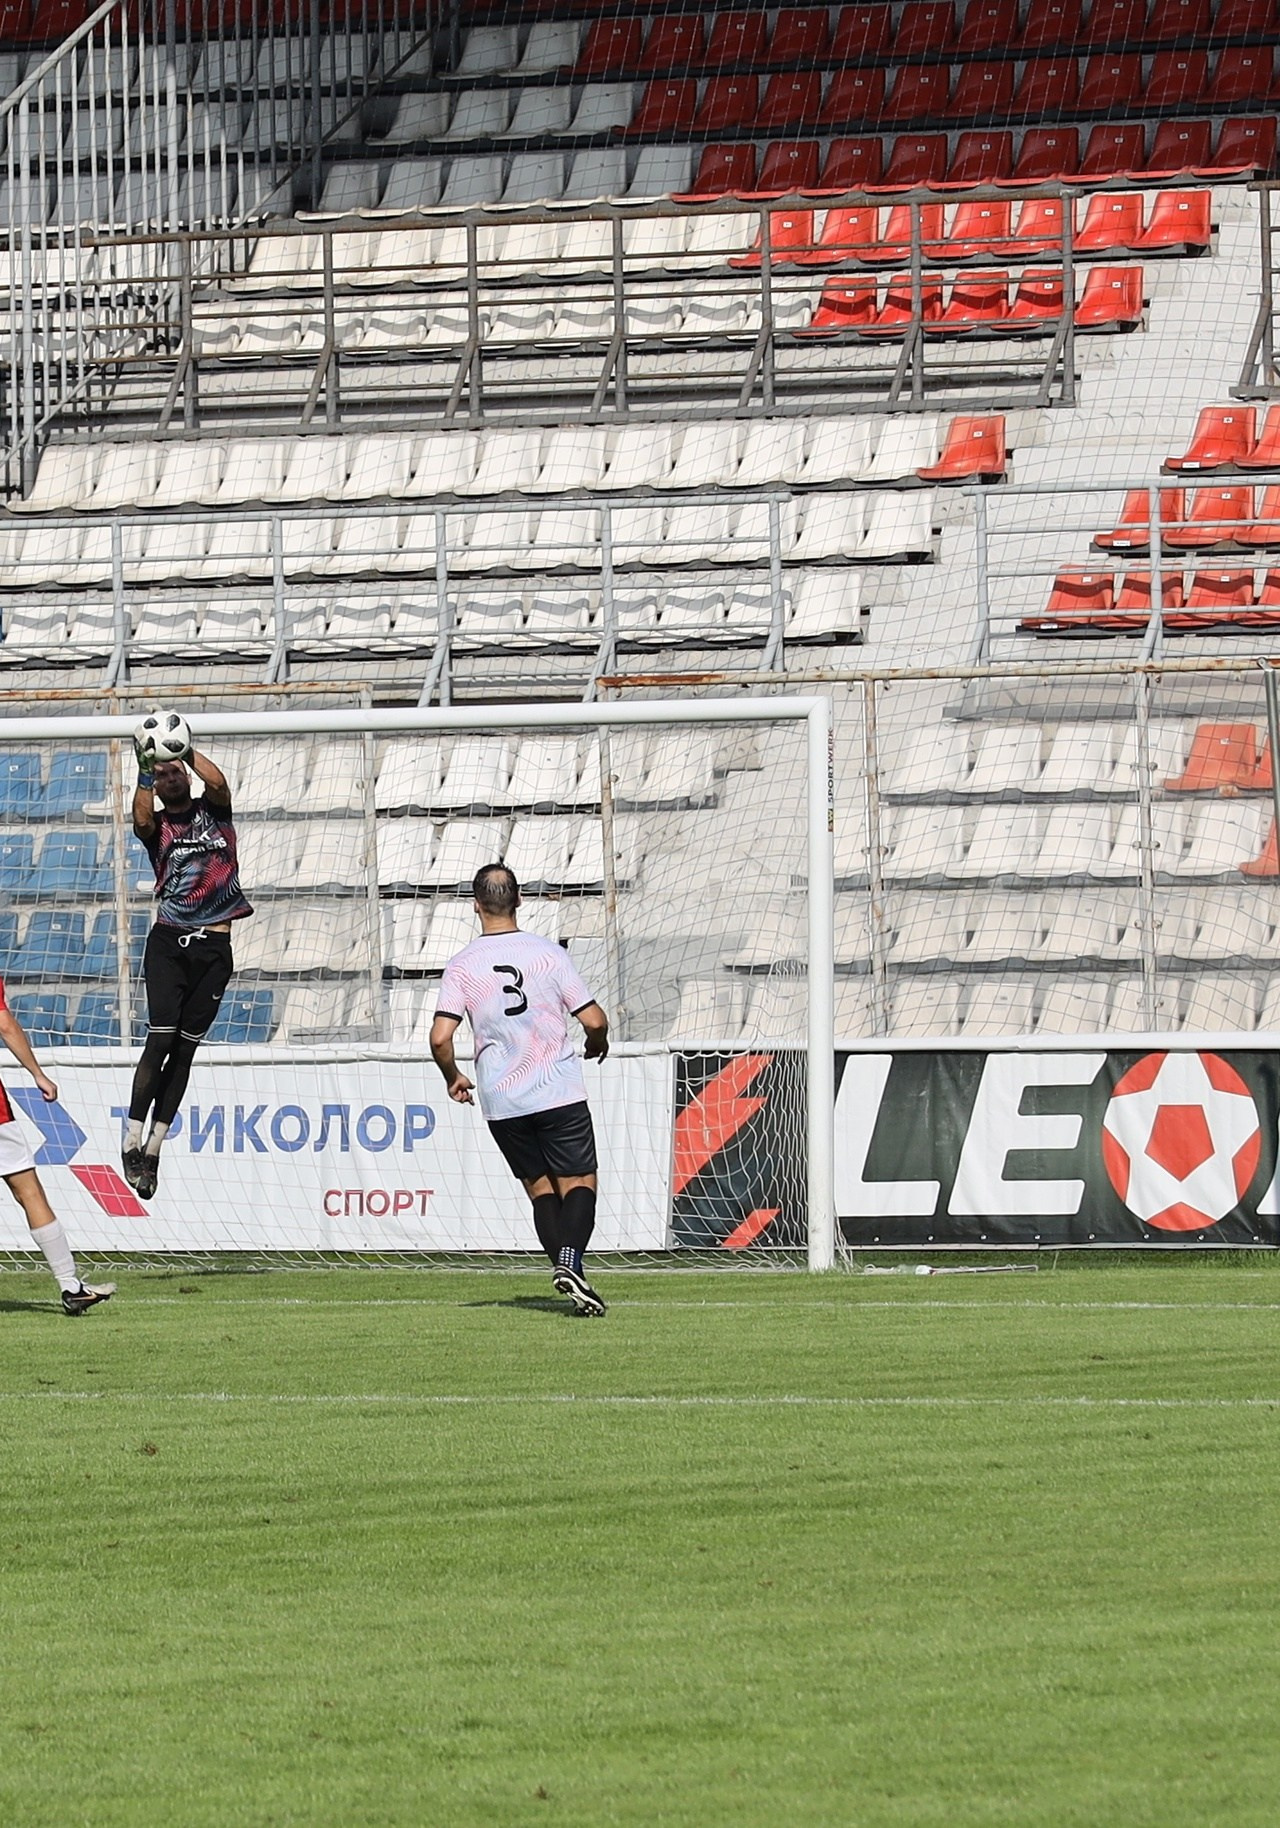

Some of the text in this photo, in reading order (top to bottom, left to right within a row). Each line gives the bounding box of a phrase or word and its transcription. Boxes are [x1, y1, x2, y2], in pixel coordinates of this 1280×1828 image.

[493, 965, 528, 1017] 3
[834, 1051, 1280, 1232] LEO
[323, 1189, 435, 1217] СПОРТ
